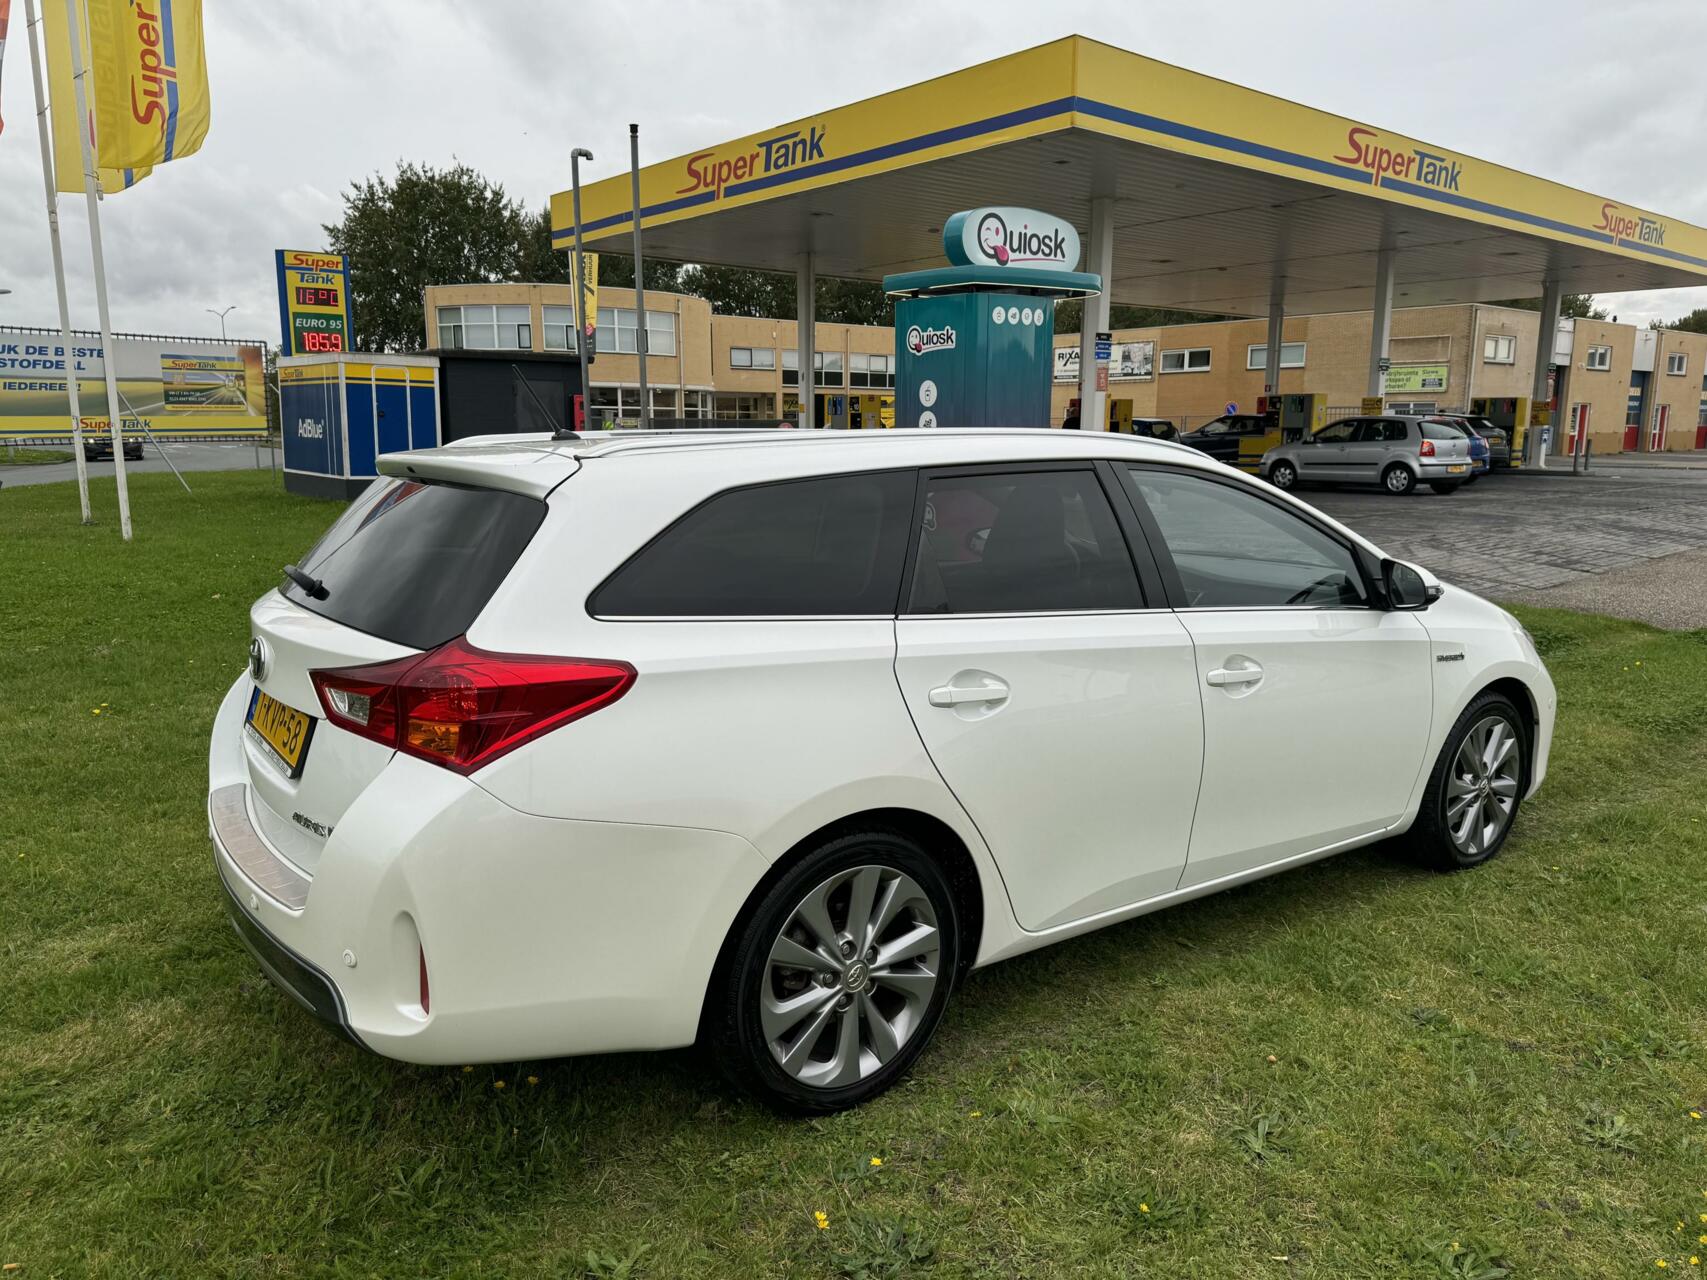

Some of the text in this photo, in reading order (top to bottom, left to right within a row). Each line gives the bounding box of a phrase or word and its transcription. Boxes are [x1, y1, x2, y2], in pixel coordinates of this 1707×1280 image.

[131, 0, 176, 143] Super
[977, 212, 1066, 266] Quiosk
[287, 253, 342, 272] Super
[296, 271, 335, 285] Tank
[295, 318, 342, 329] EURO 95
[303, 332, 342, 352] 185.9
[908, 327, 954, 352] Quiosk
[25, 345, 49, 356] DE
[3, 381, 81, 391] IEDEREE!
